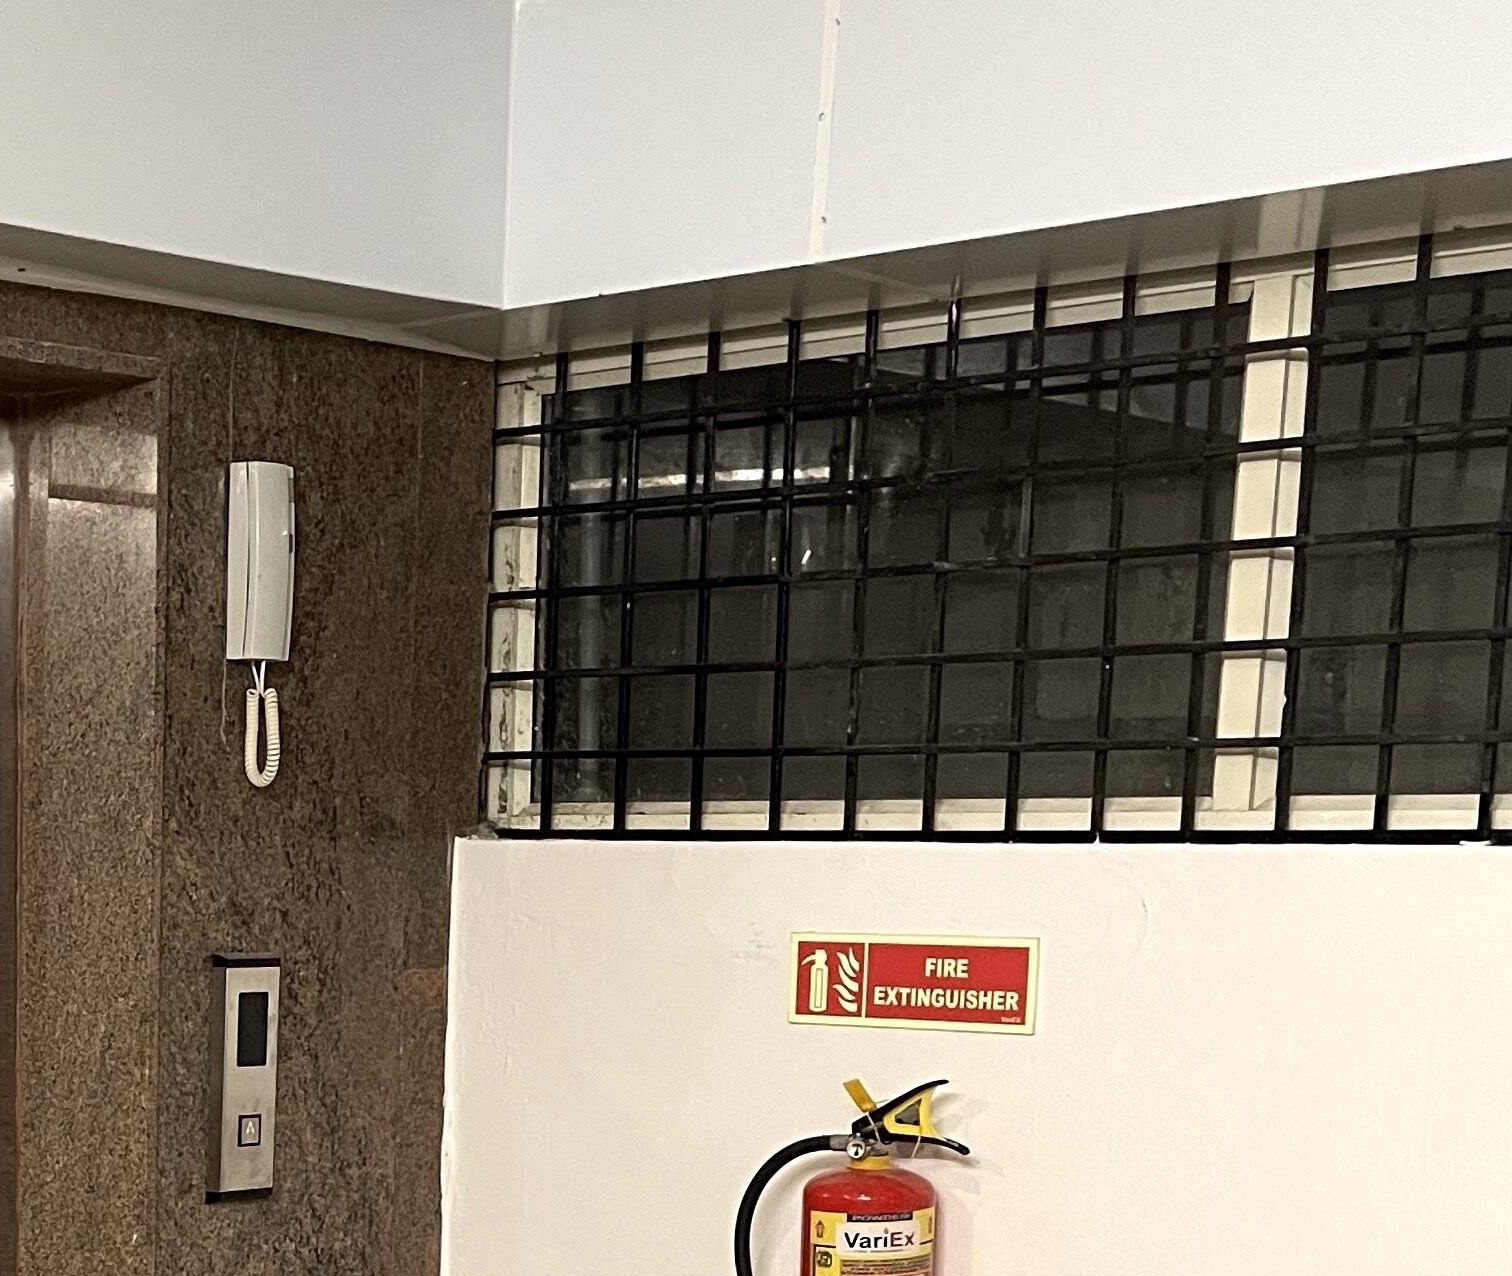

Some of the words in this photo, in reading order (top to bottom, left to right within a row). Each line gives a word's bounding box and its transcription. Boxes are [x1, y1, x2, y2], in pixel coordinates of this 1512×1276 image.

[925, 957, 969, 979] FIRE
[873, 986, 1020, 1011] EXTINGUISHER
[844, 1228, 915, 1248] VariEx
